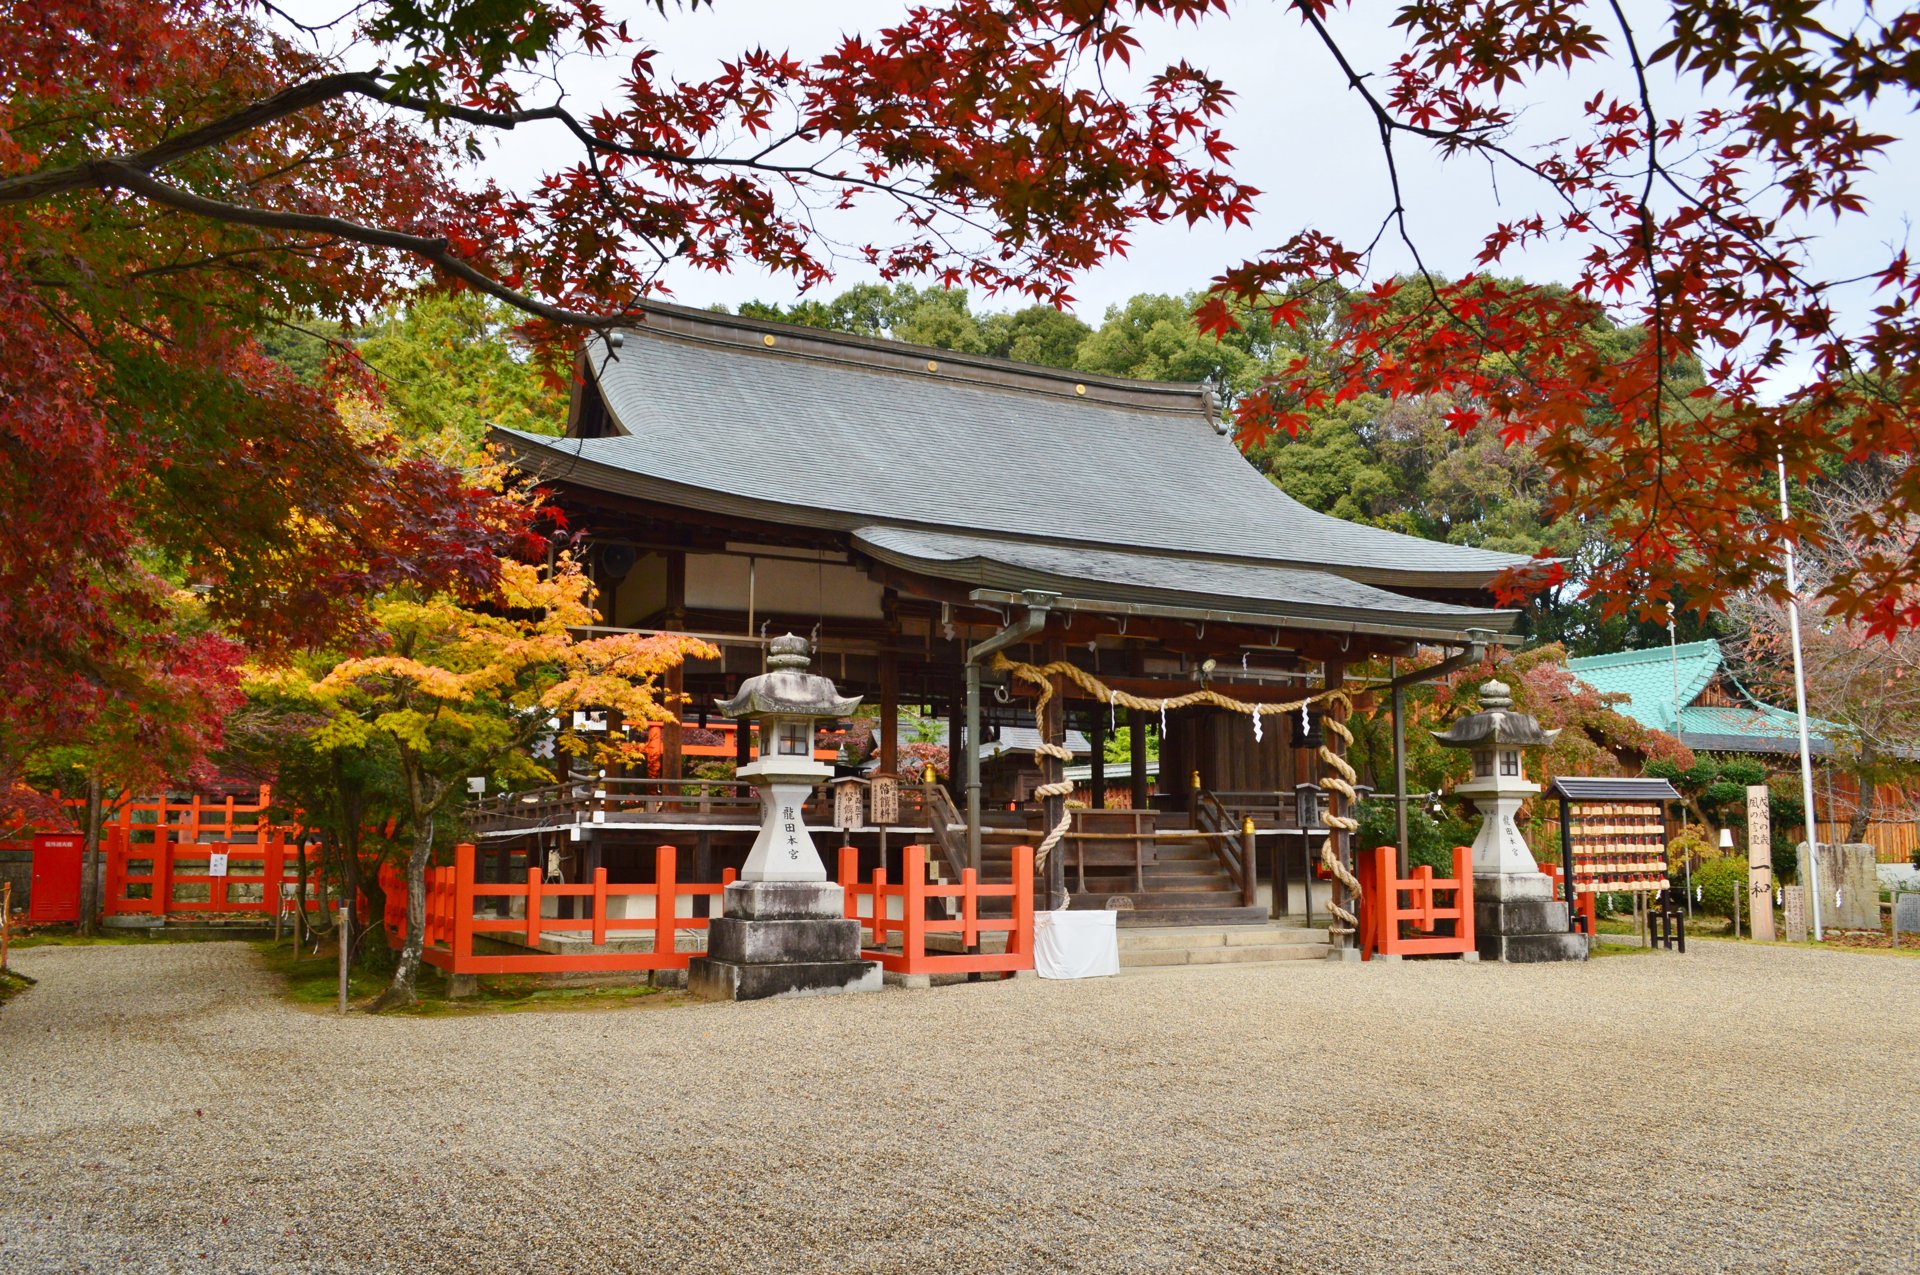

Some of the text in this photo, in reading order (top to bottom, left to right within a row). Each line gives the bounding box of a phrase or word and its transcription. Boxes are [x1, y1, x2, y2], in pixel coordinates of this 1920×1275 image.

[782, 806, 799, 860] 龍田本宮
[1503, 815, 1519, 857] 龍田本宮
